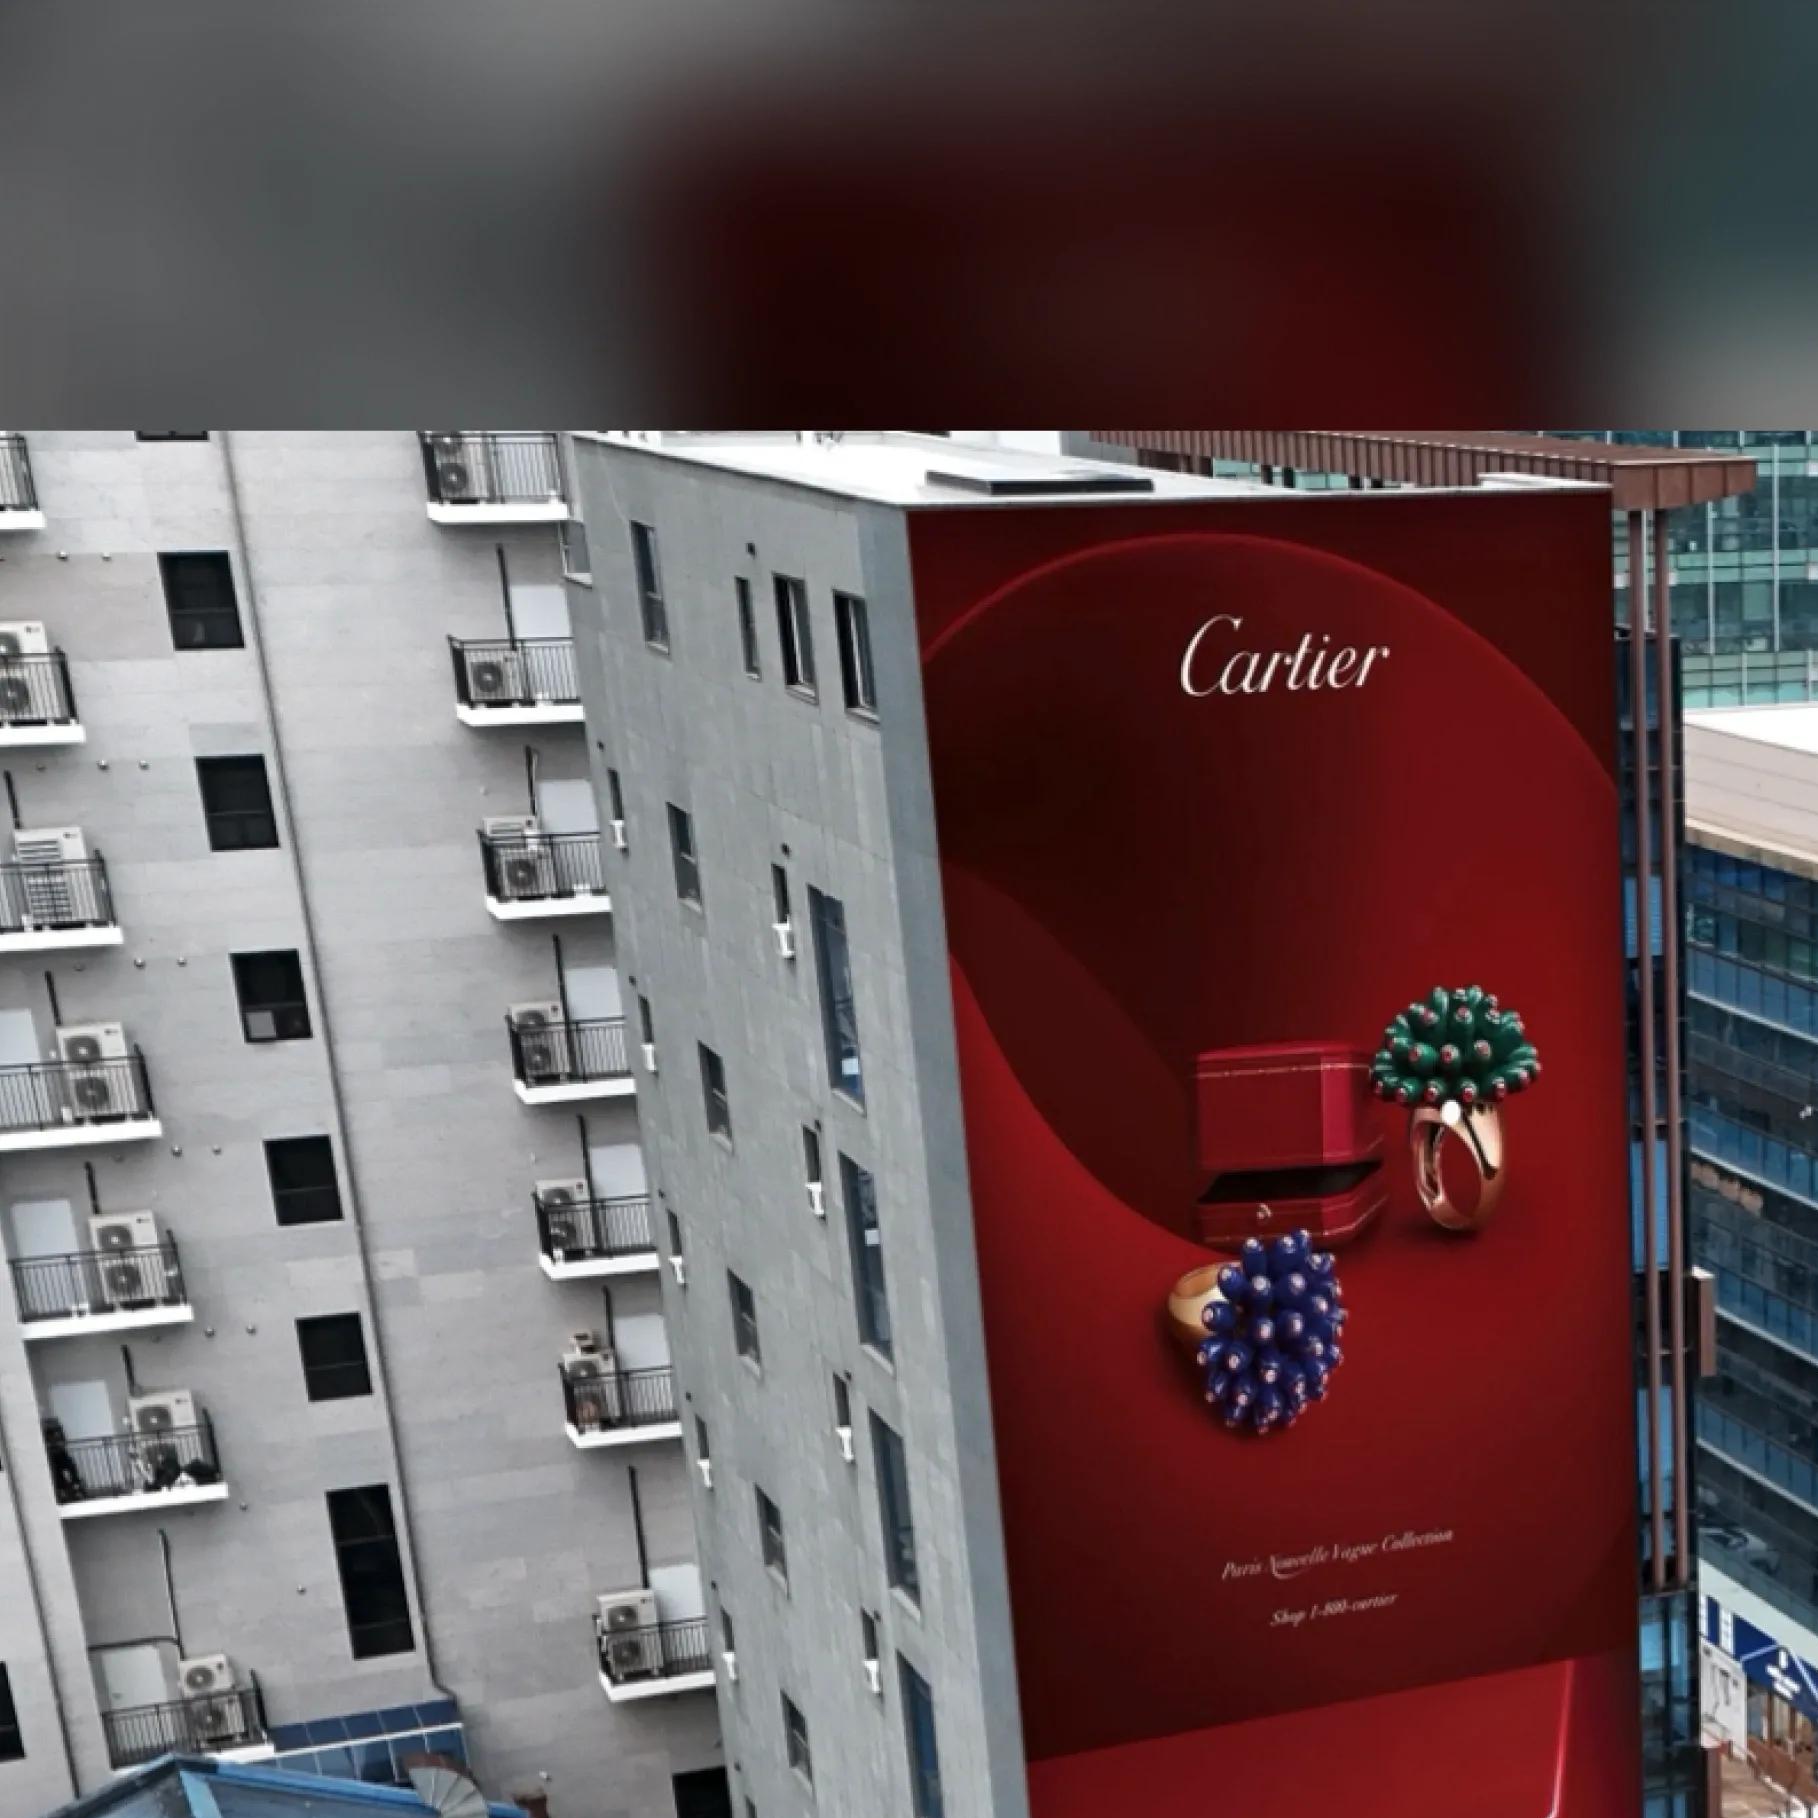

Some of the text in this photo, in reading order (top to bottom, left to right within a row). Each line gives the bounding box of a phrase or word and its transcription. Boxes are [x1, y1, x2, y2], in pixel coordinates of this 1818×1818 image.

[1181, 613, 1390, 697] Cartier
[1222, 1556, 1261, 1580] Paris
[1332, 1542, 1378, 1563] Vague
[1382, 1529, 1453, 1552] Collection
[1270, 1608, 1305, 1627] Shop
